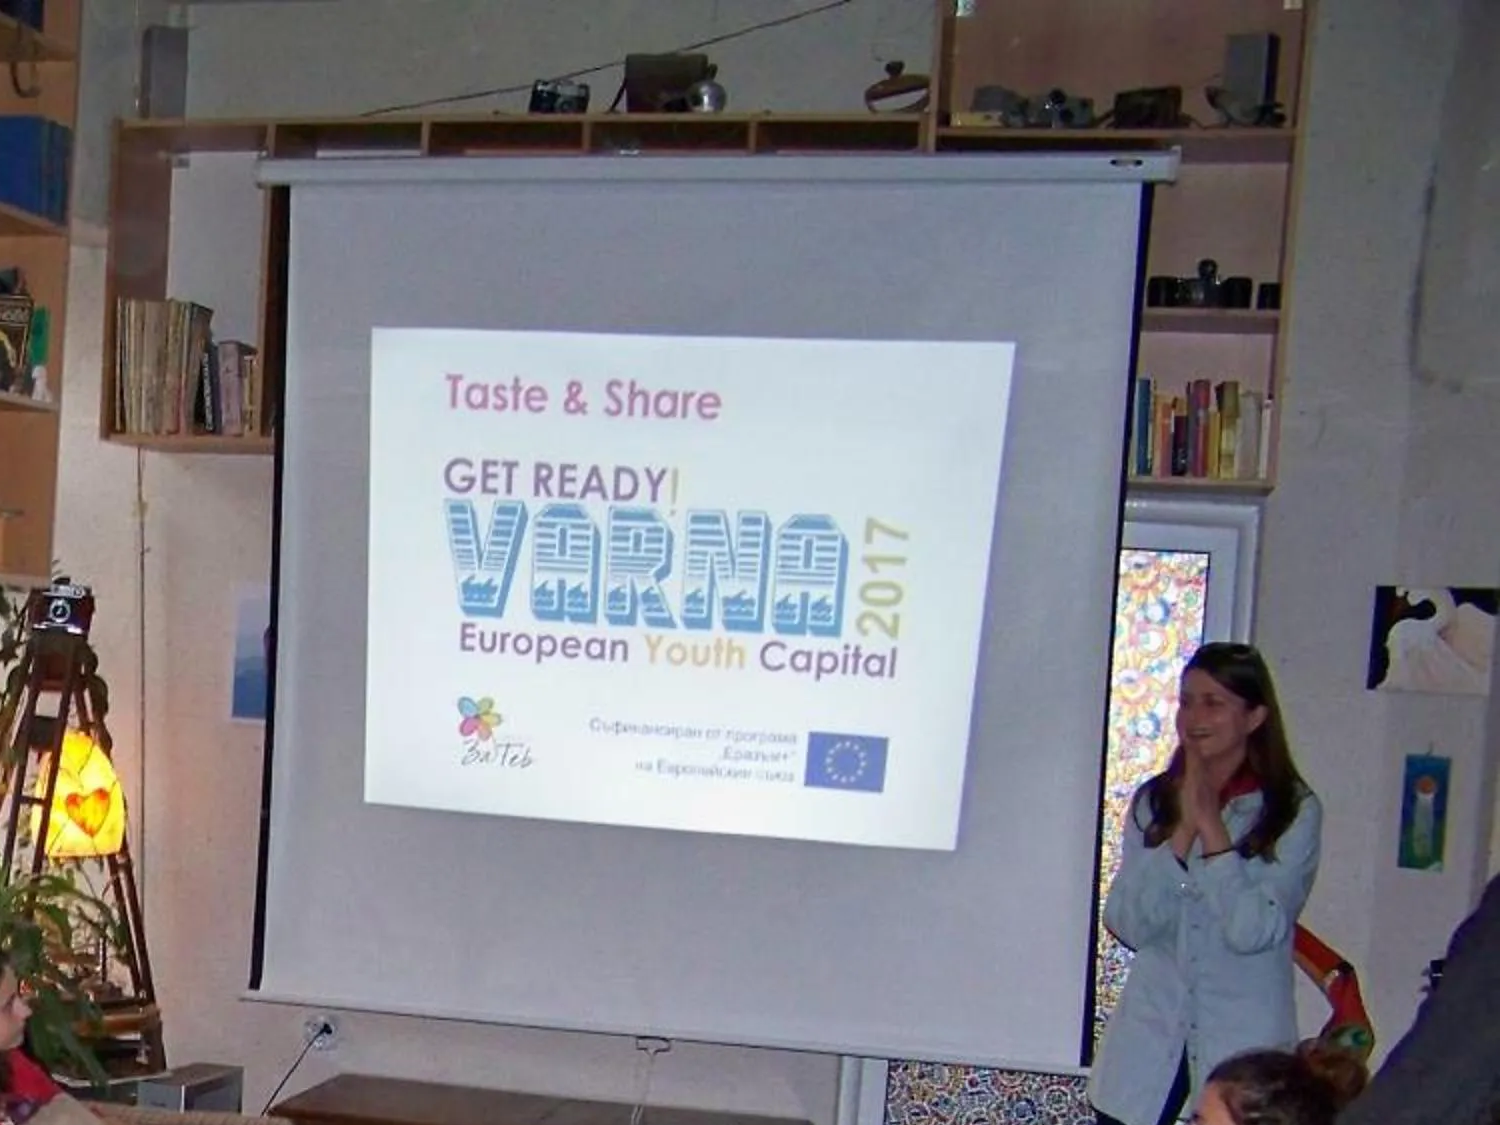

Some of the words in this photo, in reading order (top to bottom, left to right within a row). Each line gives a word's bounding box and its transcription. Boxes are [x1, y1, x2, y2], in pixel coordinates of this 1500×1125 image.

[445, 373, 549, 414] Taste
[562, 380, 588, 415] &
[603, 379, 723, 421] Share
[443, 457, 520, 495] GET
[532, 461, 680, 516] READY!
[443, 498, 850, 638] VARNA
[855, 515, 911, 641] 2017
[458, 621, 630, 665] European
[643, 634, 747, 670] Youth
[758, 639, 899, 682] Capital
